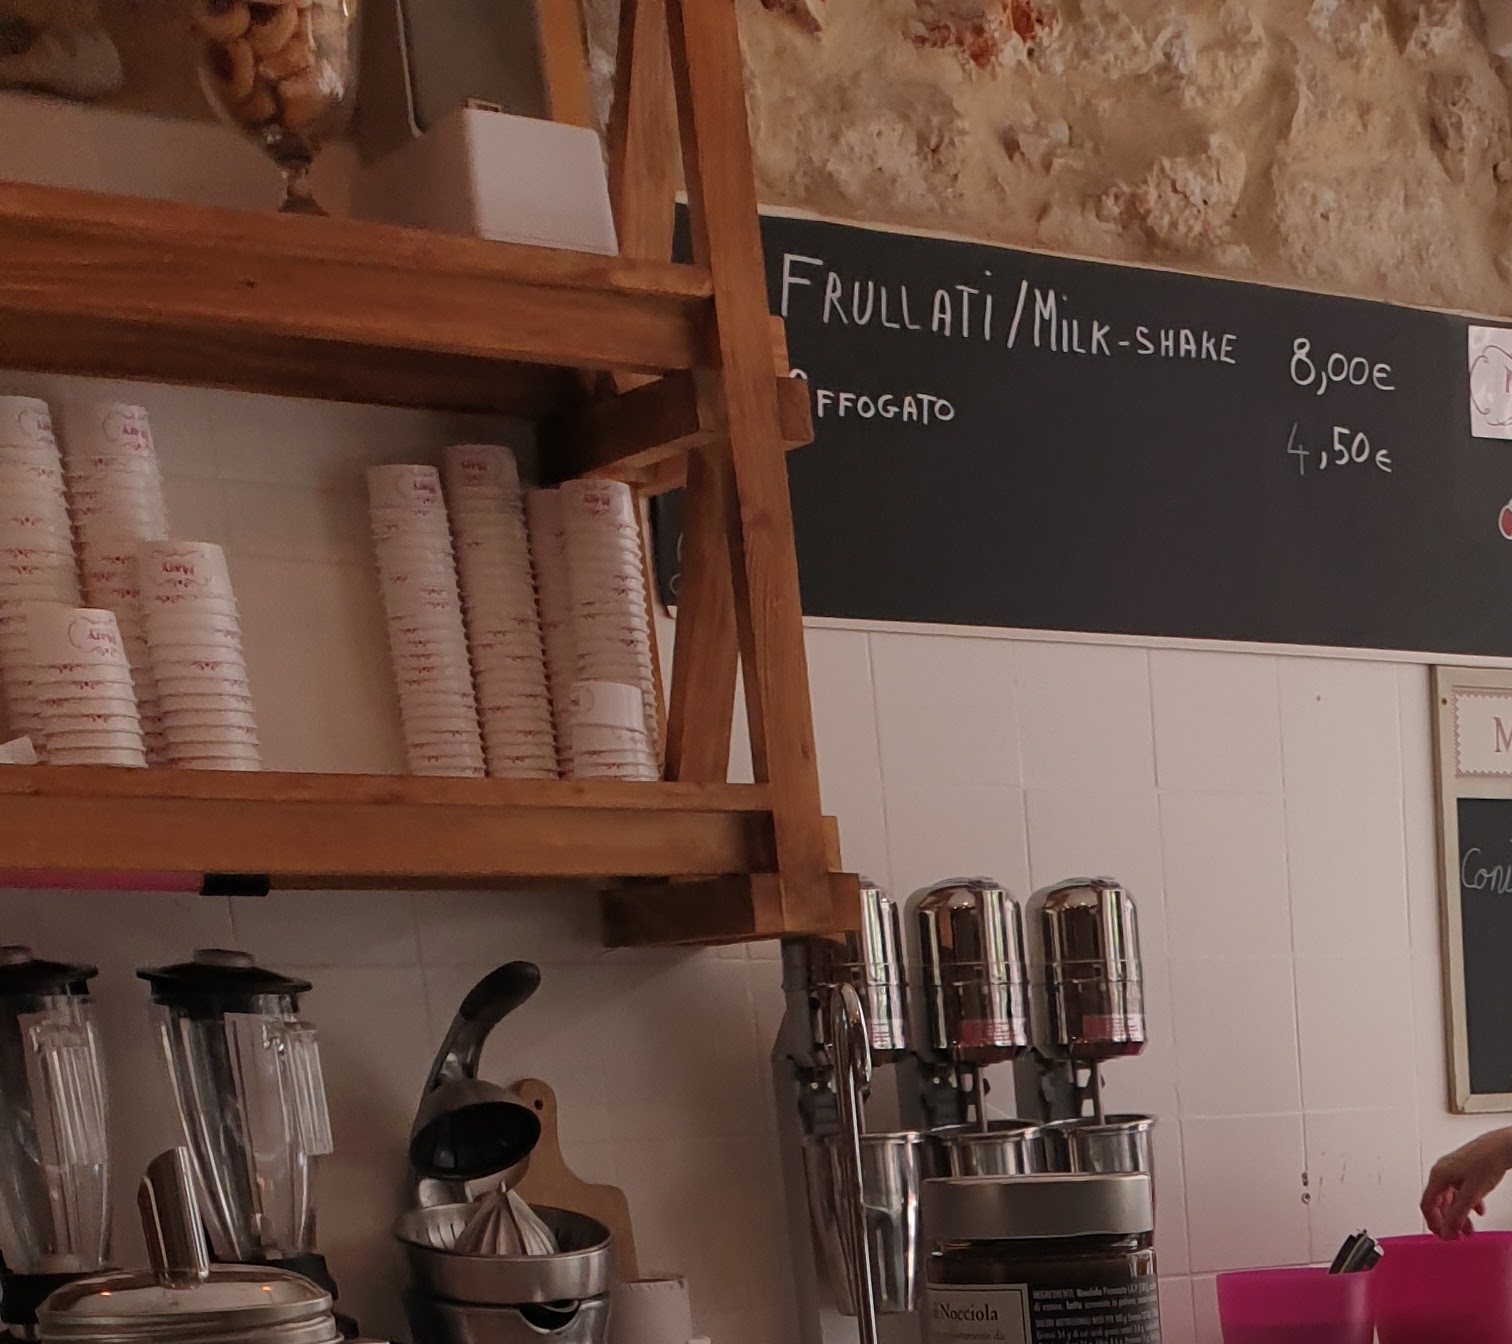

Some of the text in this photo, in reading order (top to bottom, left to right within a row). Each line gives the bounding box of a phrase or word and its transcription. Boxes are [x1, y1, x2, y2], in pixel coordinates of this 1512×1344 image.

[1289, 338, 1396, 394] 8,00€
[789, 368, 1393, 476] FFOGATO 4,50€
[940, 1303, 999, 1321] Nocciola
